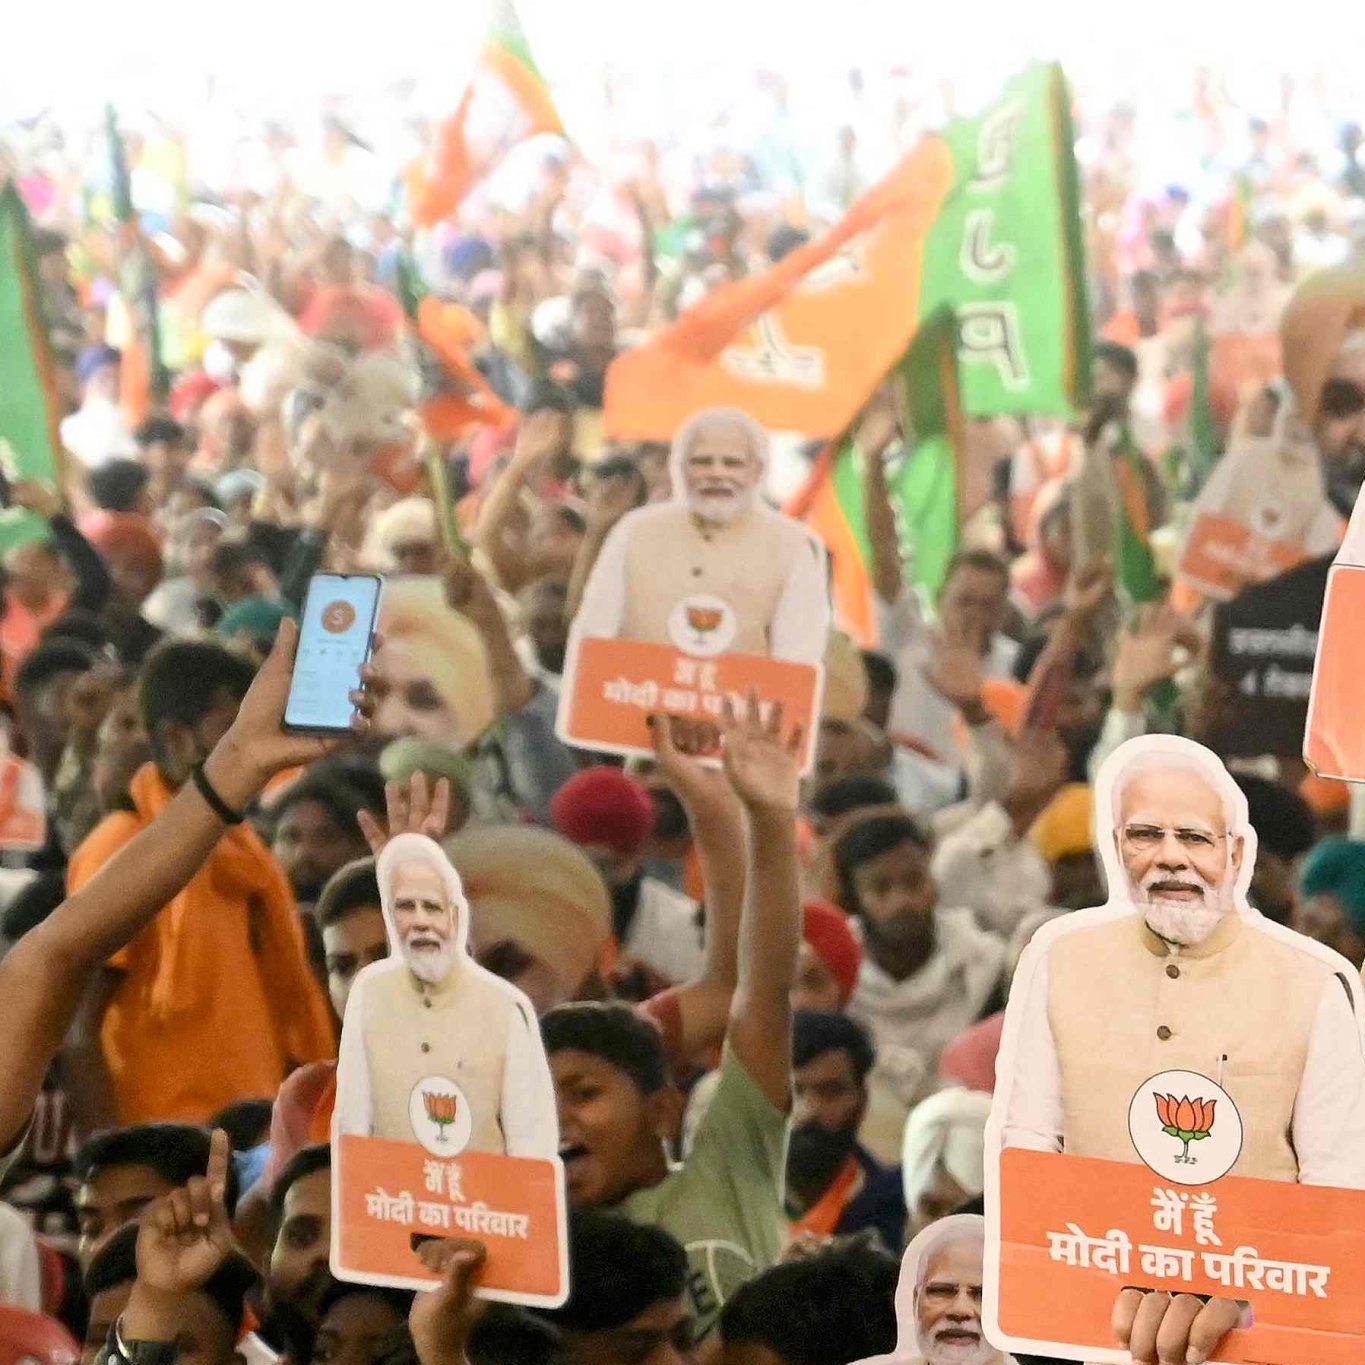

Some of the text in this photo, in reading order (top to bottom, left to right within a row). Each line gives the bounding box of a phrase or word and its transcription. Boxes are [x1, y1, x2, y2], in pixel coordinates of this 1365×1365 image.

[365, 1187, 530, 1239] मोदी का परिवार
[1151, 1187, 1222, 1246] मैं हूँ
[1046, 1222, 1331, 1298] मोदी का परिवार
